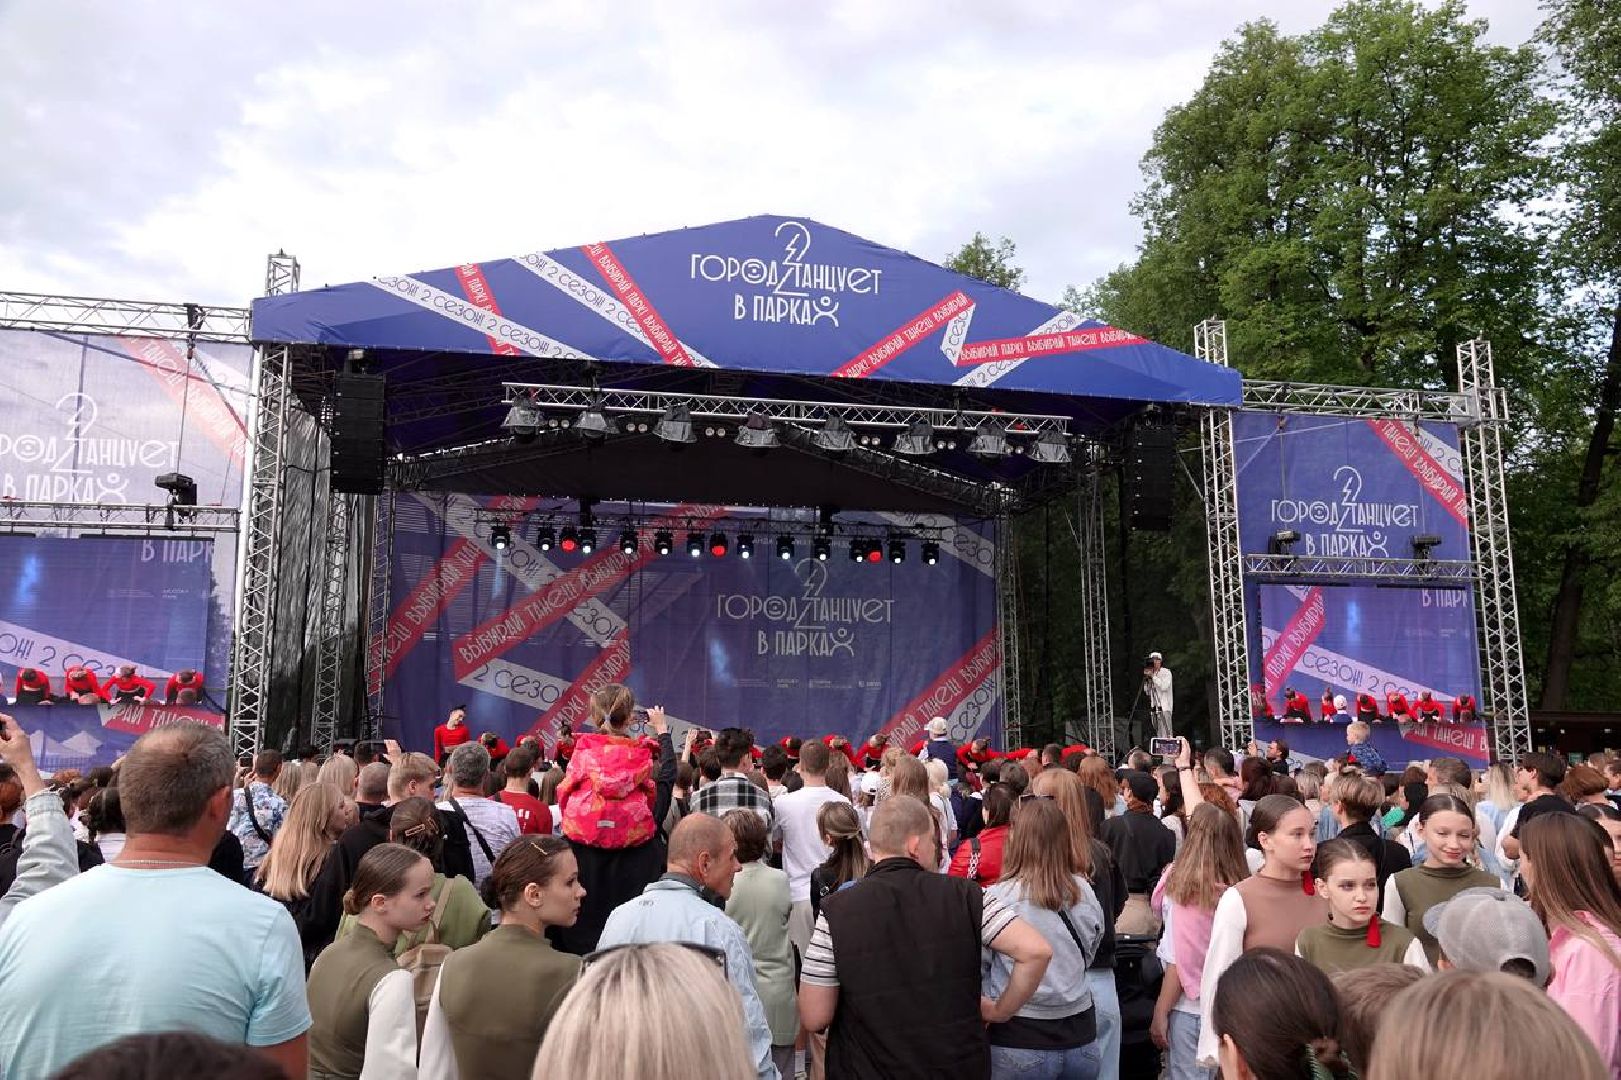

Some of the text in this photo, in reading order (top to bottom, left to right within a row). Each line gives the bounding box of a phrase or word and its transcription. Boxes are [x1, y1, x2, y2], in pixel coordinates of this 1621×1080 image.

[690, 253, 778, 287] ГОРОД
[548, 266, 559, 278] 2
[605, 302, 616, 315] 2
[420, 288, 432, 302] 2
[487, 318, 498, 331] 2
[734, 293, 746, 320] В
[3, 473, 17, 501] В
[1271, 499, 1339, 526] ГОРОД
[1305, 533, 1316, 555] В
[717, 594, 798, 622] ГОРОД
[758, 629, 769, 655] В
[39, 645, 57, 667] 2
[494, 668, 567, 704] СЕЗО
[1368, 675, 1380, 693] 2
